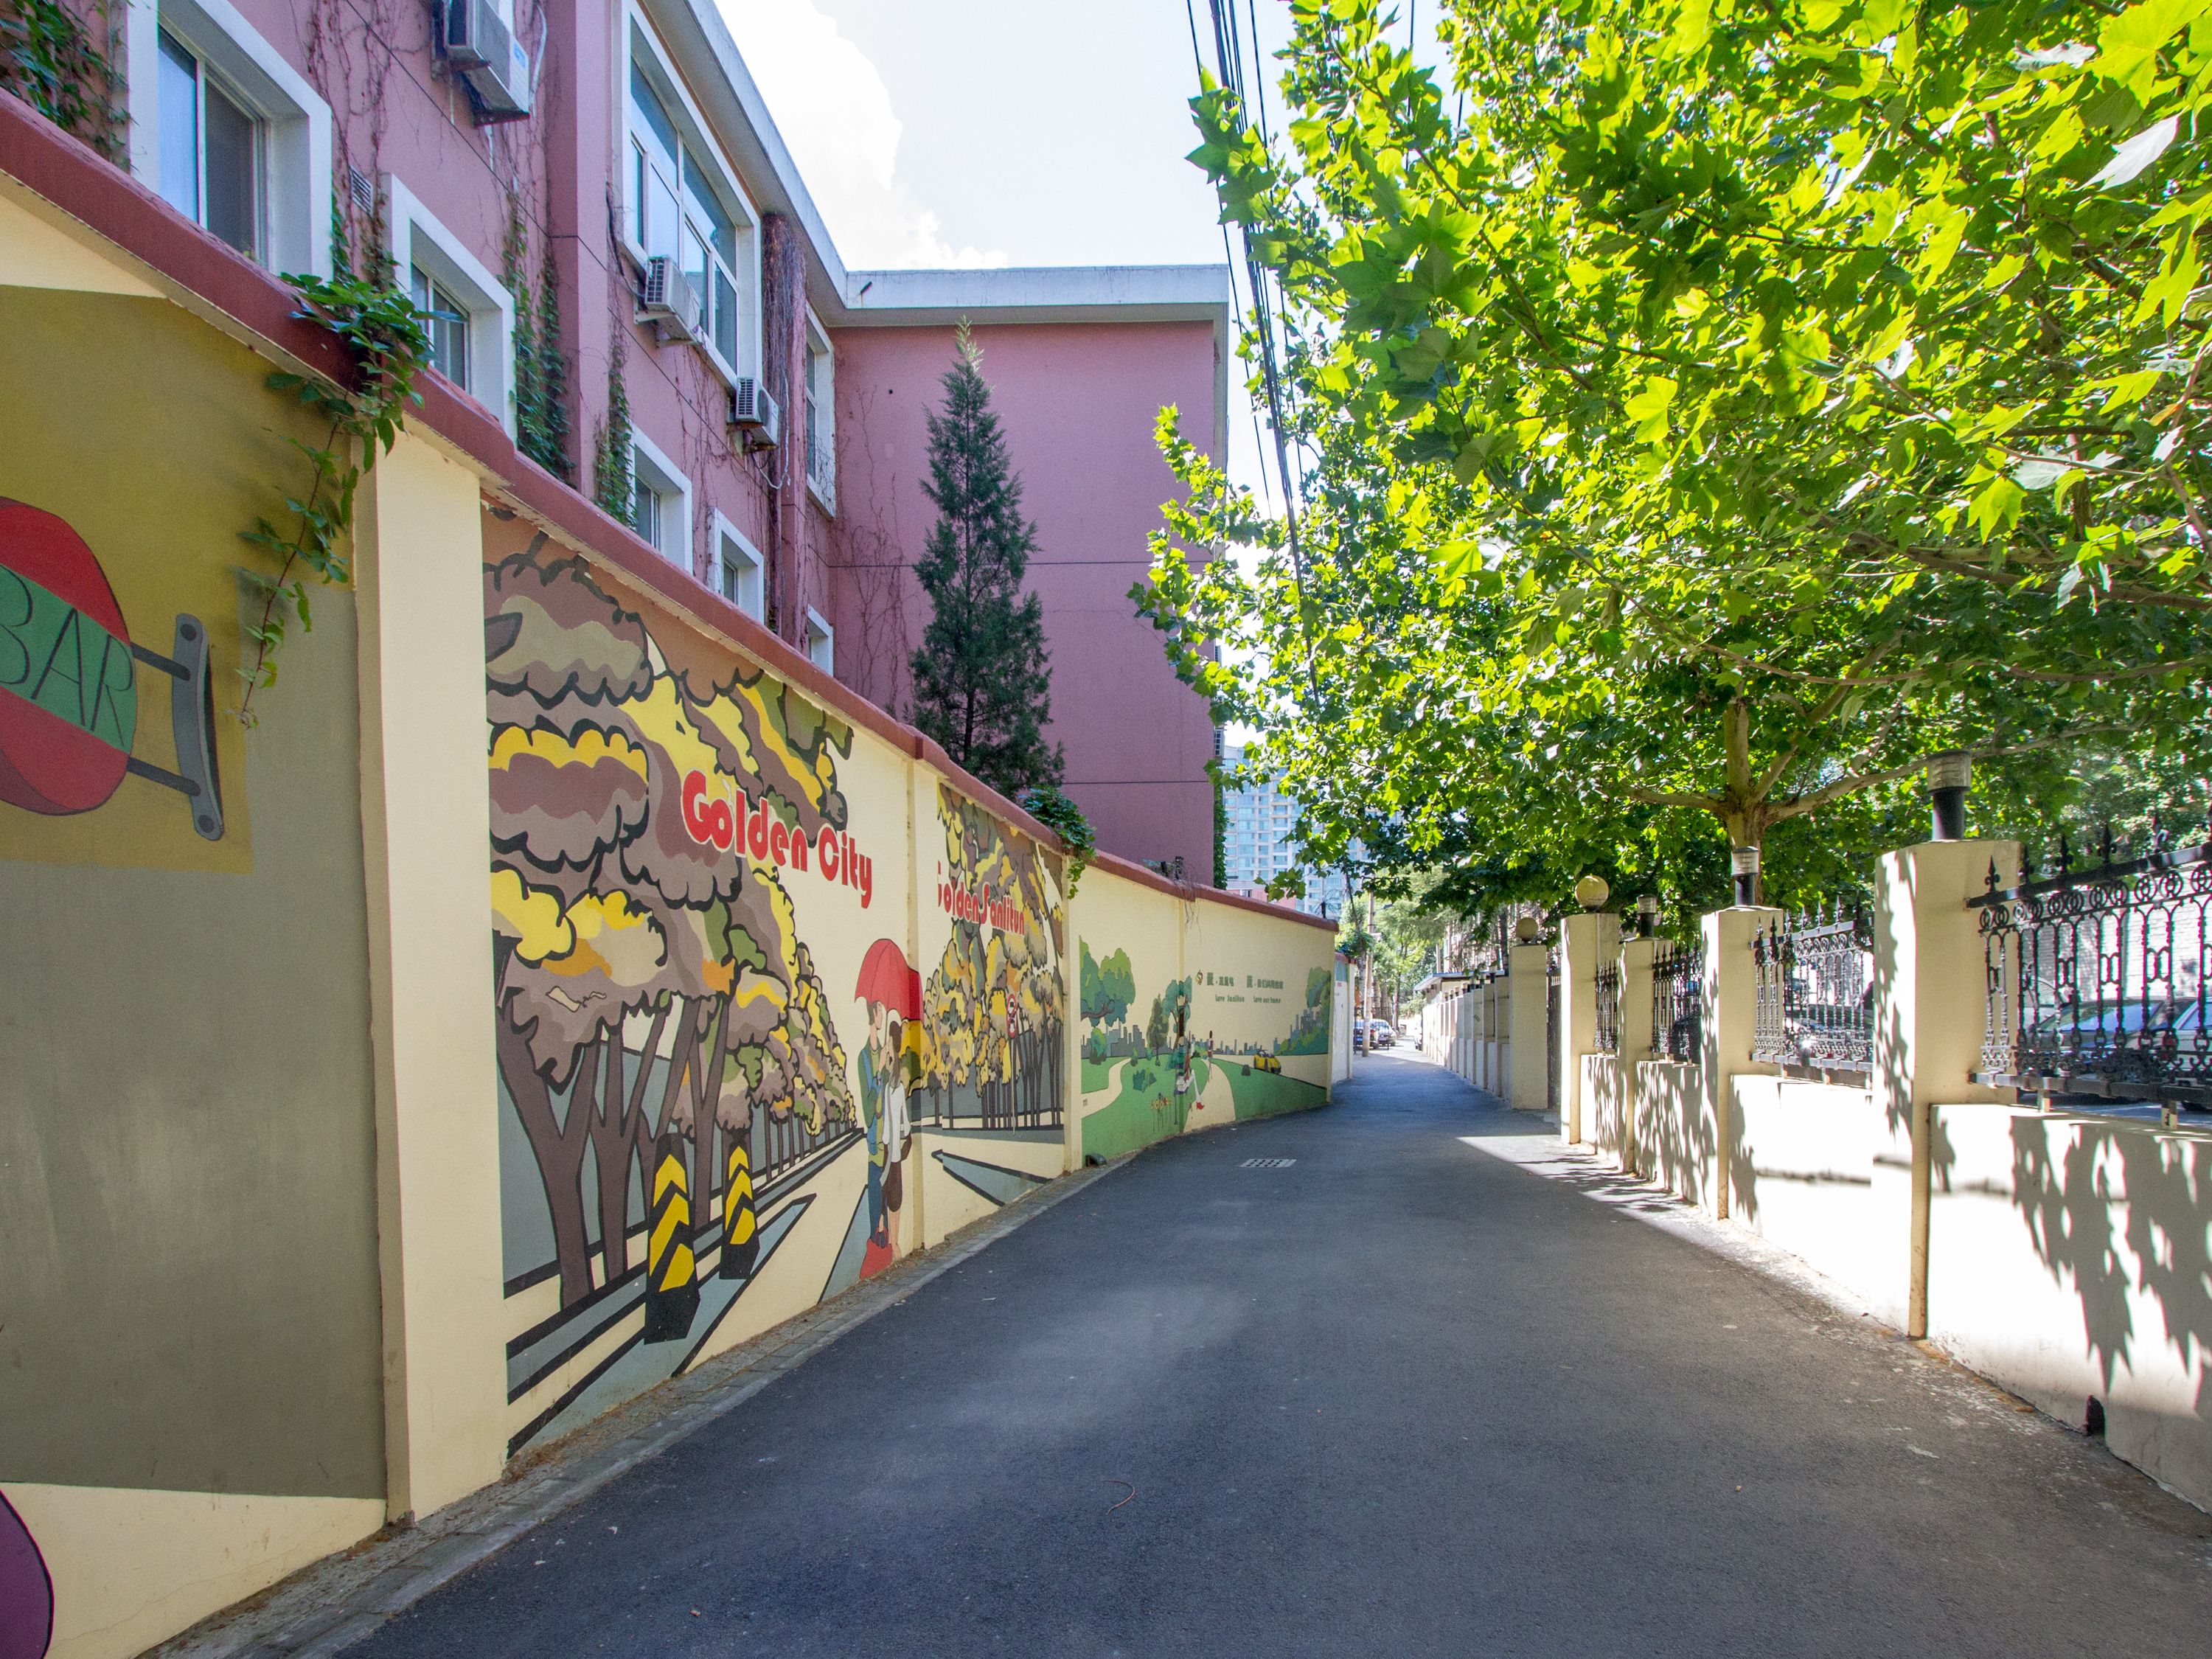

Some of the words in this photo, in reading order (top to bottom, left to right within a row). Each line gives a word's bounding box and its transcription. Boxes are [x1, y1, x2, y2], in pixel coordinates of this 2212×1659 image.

[681, 769, 808, 873] Golden
[818, 825, 872, 909] City
[980, 883, 1025, 935] Sanlitun
